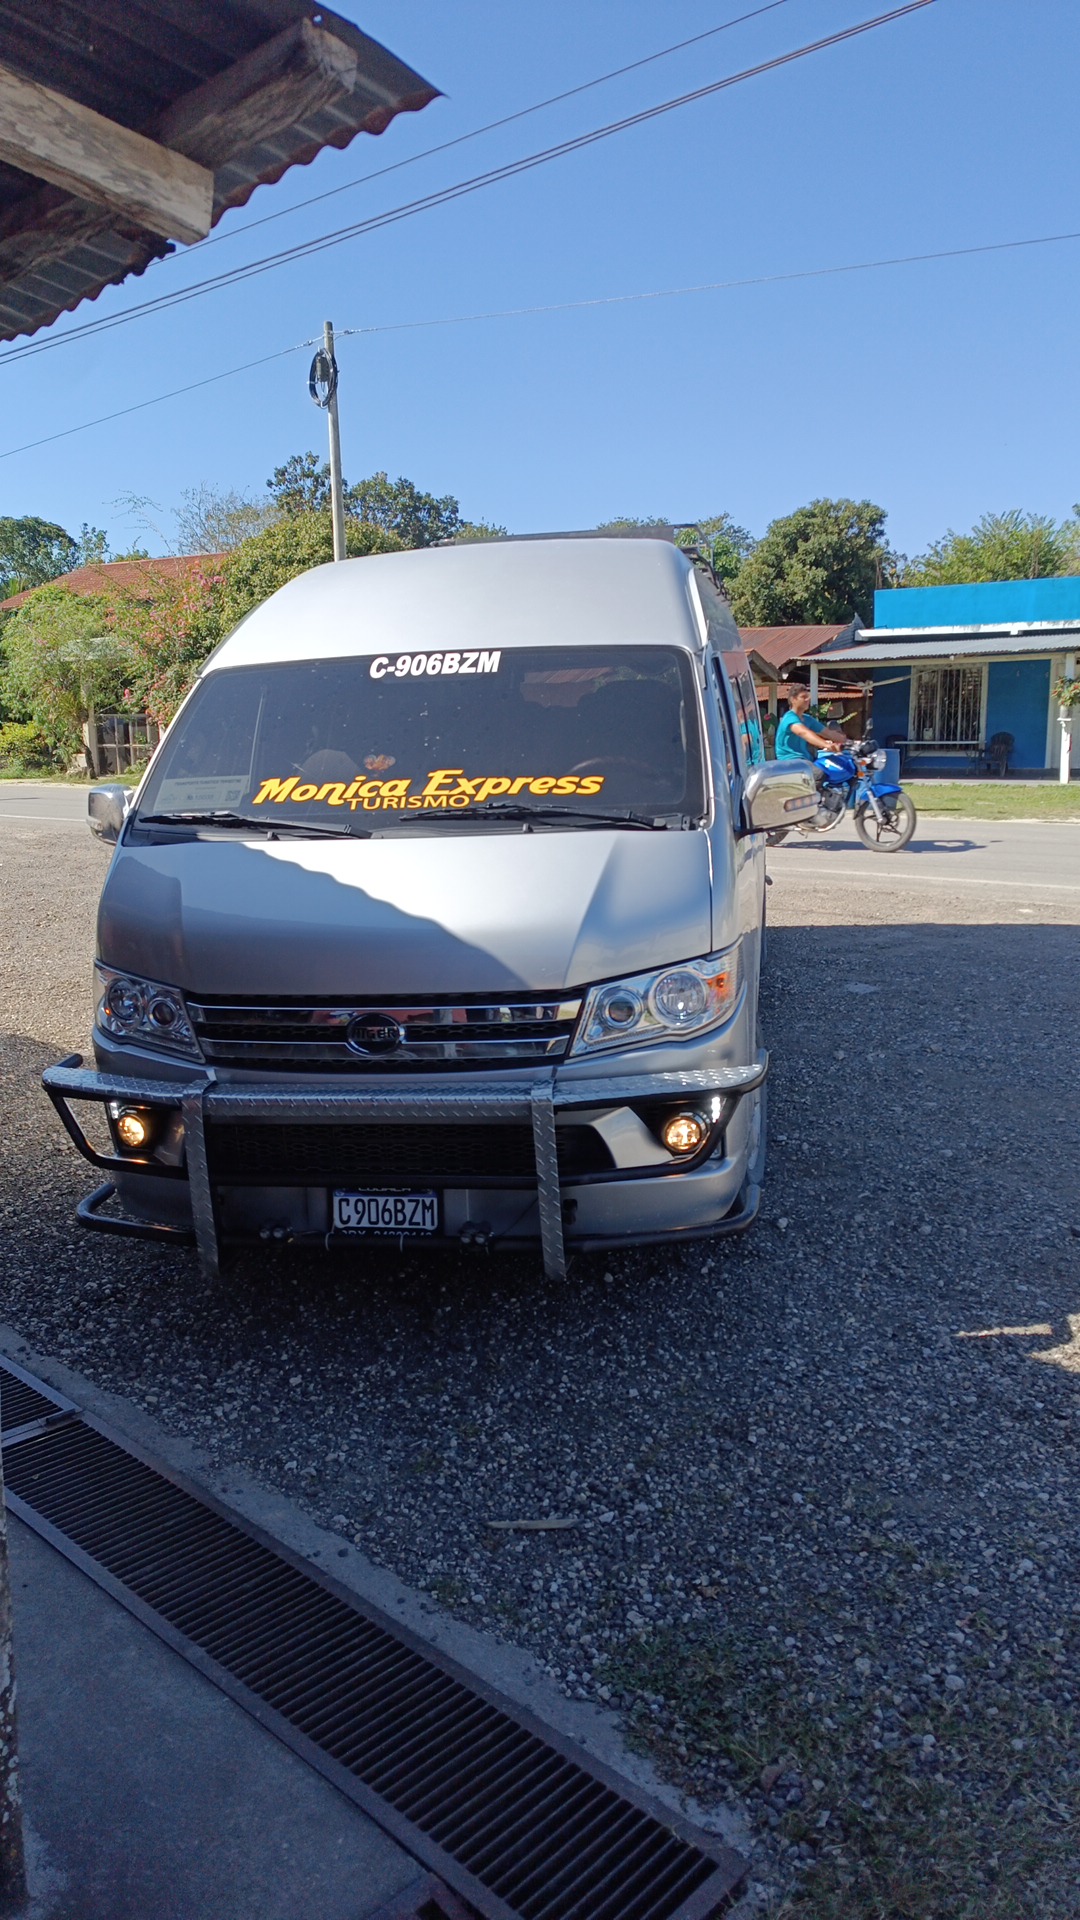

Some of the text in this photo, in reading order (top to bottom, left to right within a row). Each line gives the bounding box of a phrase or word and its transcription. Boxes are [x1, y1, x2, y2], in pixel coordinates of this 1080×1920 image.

[369, 650, 501, 679] C-906BZM
[252, 769, 605, 806] Monica Express
[346, 794, 471, 811] TURISMO
[338, 1197, 436, 1227] C906BZM
